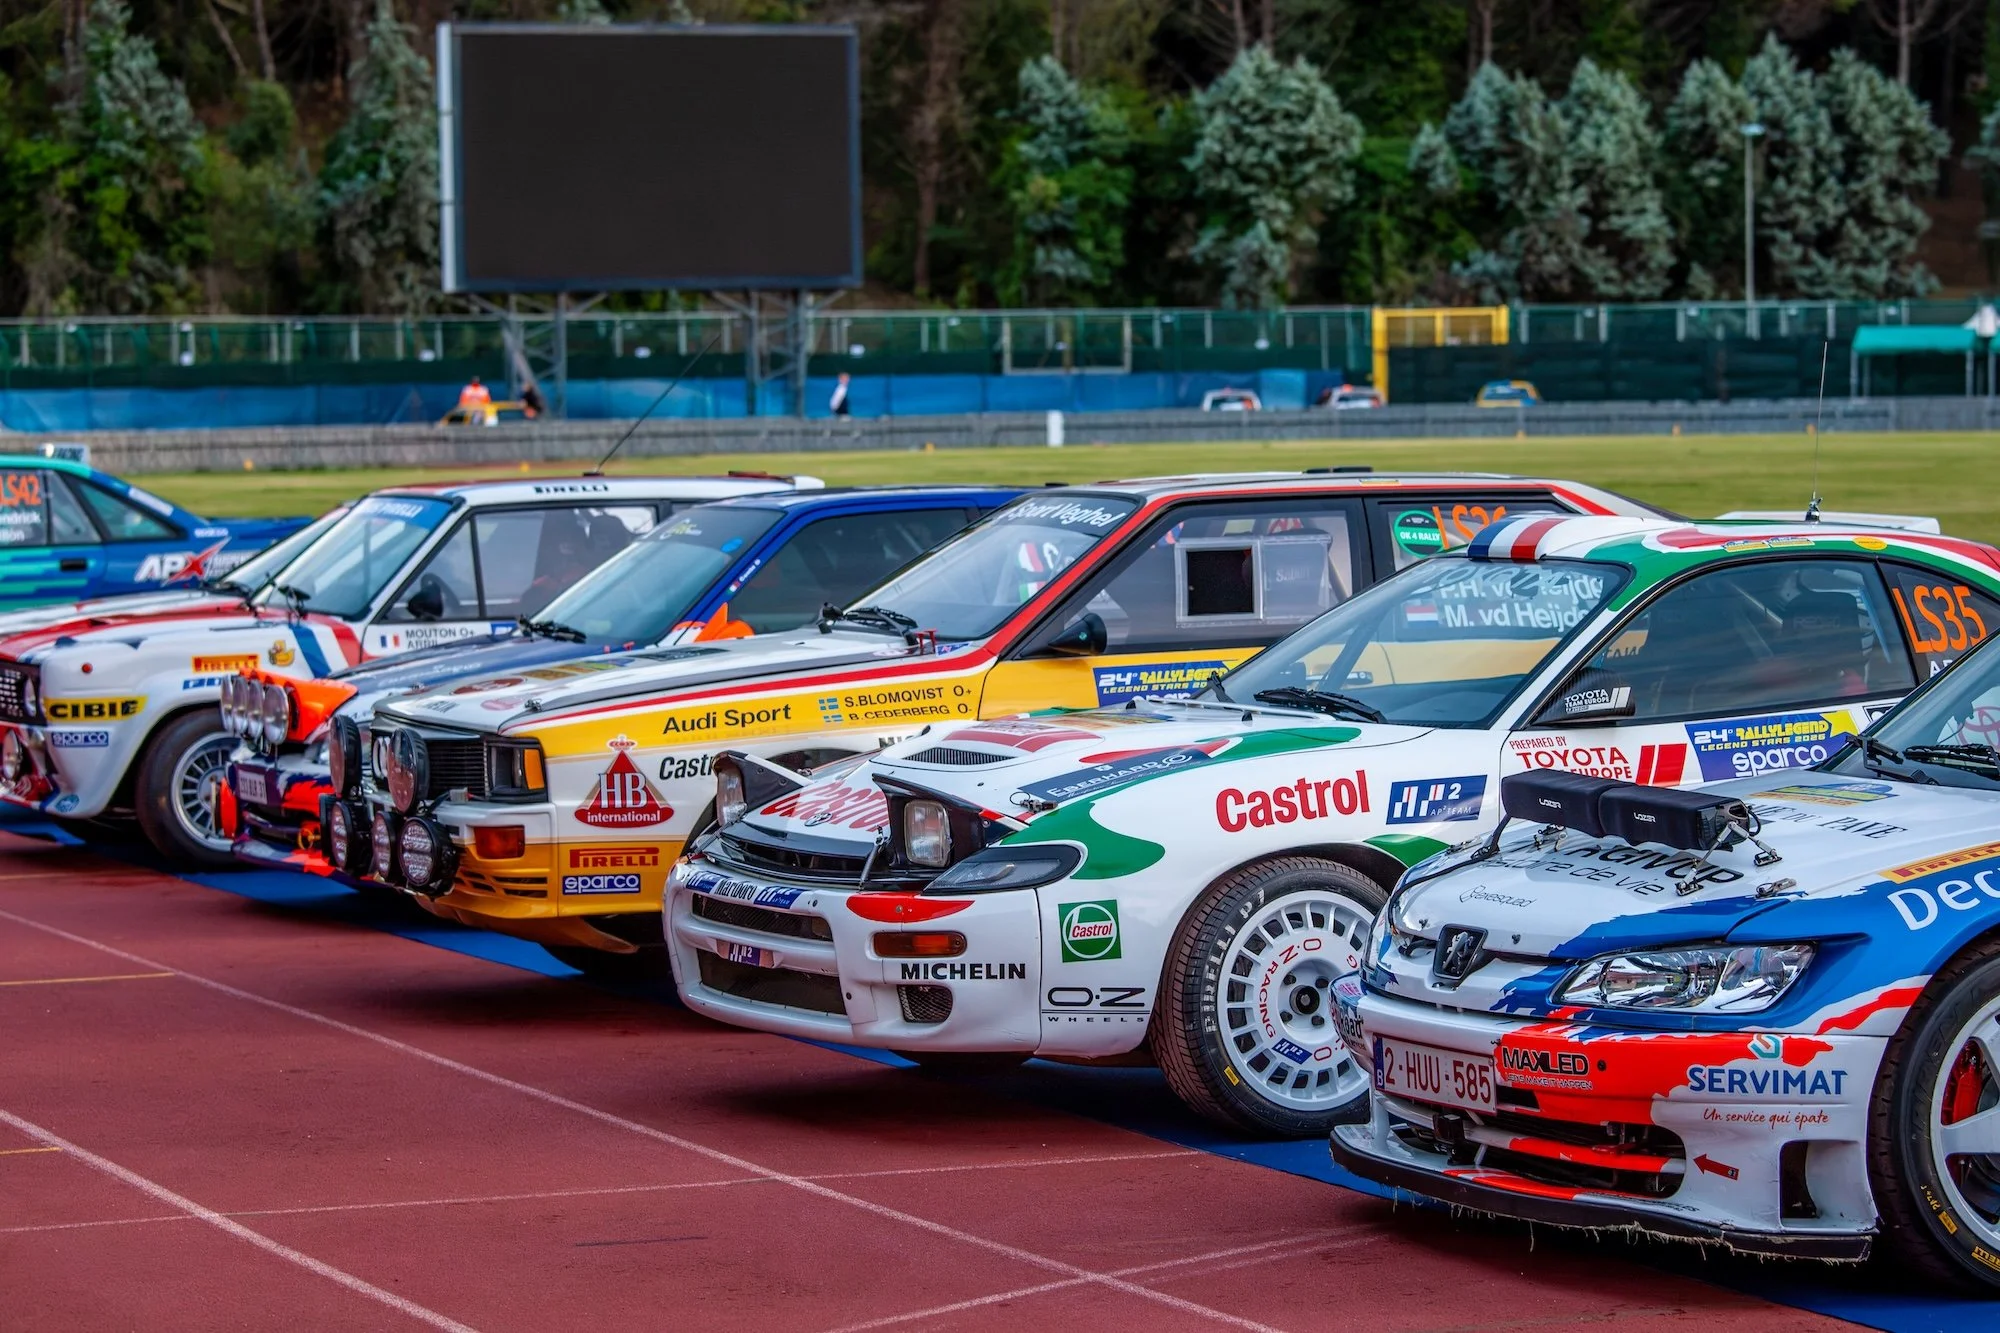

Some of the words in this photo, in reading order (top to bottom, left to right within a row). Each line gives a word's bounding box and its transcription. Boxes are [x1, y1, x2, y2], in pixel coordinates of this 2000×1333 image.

[533, 484, 610, 494] PIRELLI
[1400, 532, 1411, 540] OK
[1418, 532, 1441, 542] RALLY
[1444, 604, 1474, 628] M.
[1477, 602, 1510, 626] vd
[1892, 585, 1987, 653] LS35
[406, 627, 457, 639] MOUTON
[844, 687, 944, 708] S.BLOMQVIST
[1103, 685, 1148, 694] LEGEND
[1151, 683, 1189, 691] STARS
[1564, 688, 1609, 703] TOYOTA
[1584, 697, 1610, 705] EUROPE
[662, 710, 717, 735] Audi
[724, 704, 792, 729] Sport
[53, 732, 107, 746] sparco
[1736, 720, 1829, 741] RALLYLEGEND
[1509, 736, 1554, 750] PREPARED
[1555, 735, 1568, 748] BY
[1701, 742, 1748, 752] LEGEND
[1752, 737, 1790, 747] STARS
[1516, 746, 1630, 770] TOYOTA
[1732, 744, 1828, 778] sparco
[1047, 761, 1162, 797] EBERHARD
[598, 771, 648, 810] HB
[1216, 769, 1371, 833] Castrol
[586, 810, 661, 823] international
[569, 847, 660, 869] PIRELLI
[564, 874, 640, 894] sparco
[1072, 922, 1113, 938] Castrol
[901, 963, 1026, 980] MICHELIN
[1259, 960, 1279, 1038] RACING
[1502, 1046, 1589, 1077] MAXLED
[1377, 1067, 1384, 1087] B
[1525, 1074, 1548, 1086] MAKE
[1557, 1078, 1593, 1090] HAPPEN
[1688, 1067, 1848, 1095] SERVIMAT
[1703, 1107, 1724, 1121] Un
[1725, 1110, 1766, 1123] service
[1769, 1111, 1792, 1131] qui
[1794, 1108, 1829, 1131] épate
